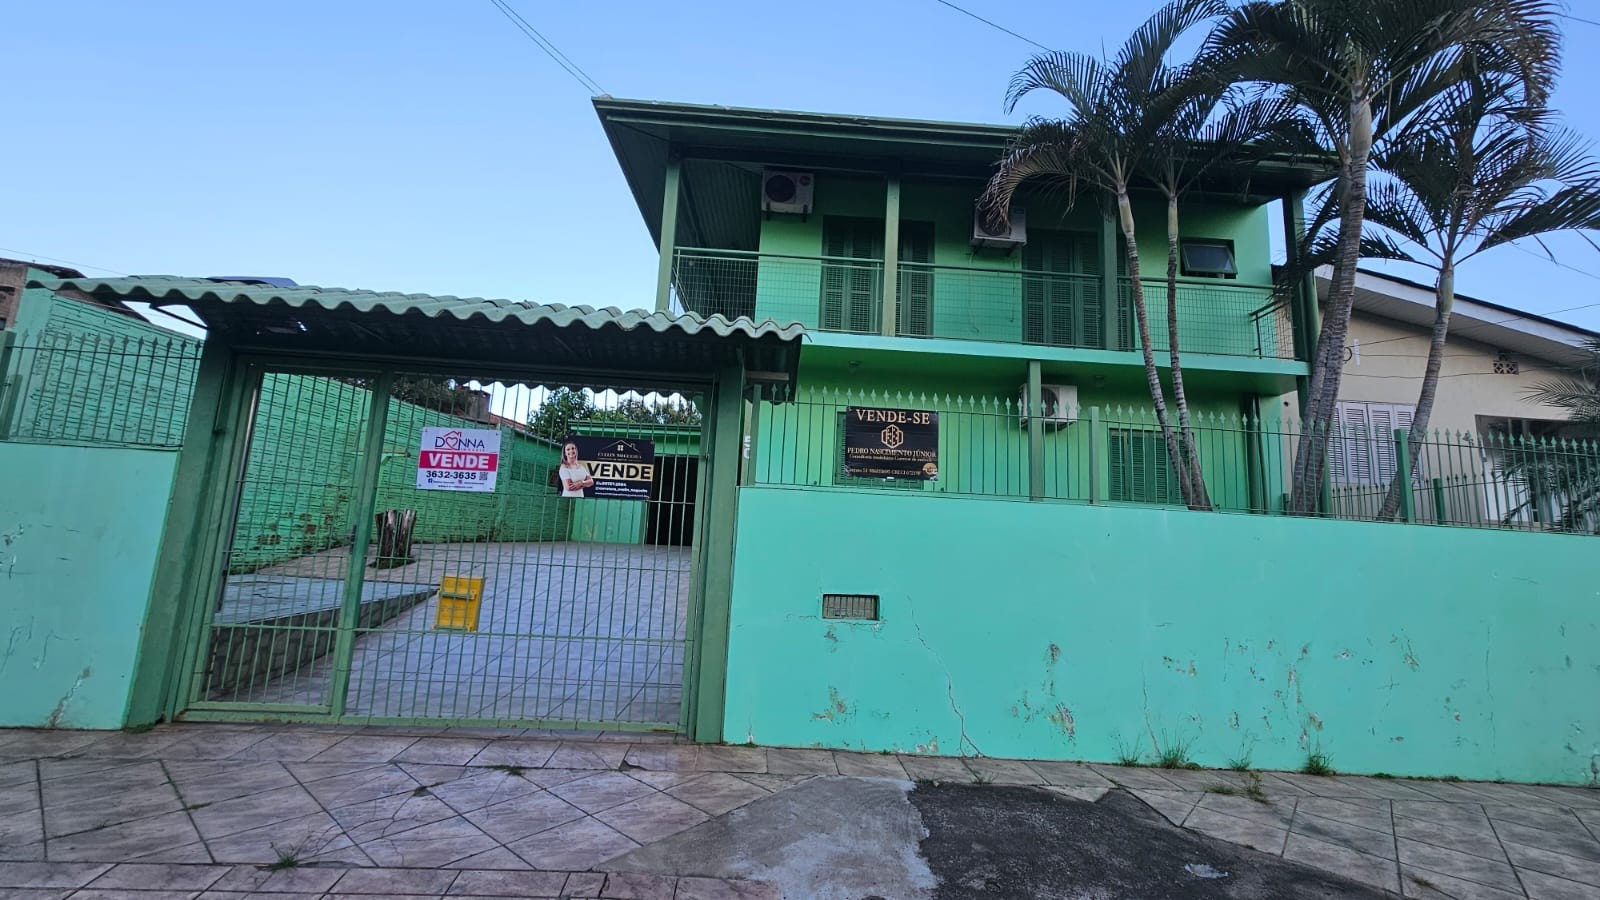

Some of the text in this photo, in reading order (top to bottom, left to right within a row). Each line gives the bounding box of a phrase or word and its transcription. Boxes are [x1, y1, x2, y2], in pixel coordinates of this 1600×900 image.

[856, 409, 930, 425] VENDE-SE
[428, 453, 490, 469] VENDE
[426, 470, 477, 480] 3632-3635
[586, 462, 652, 480] VENDE
